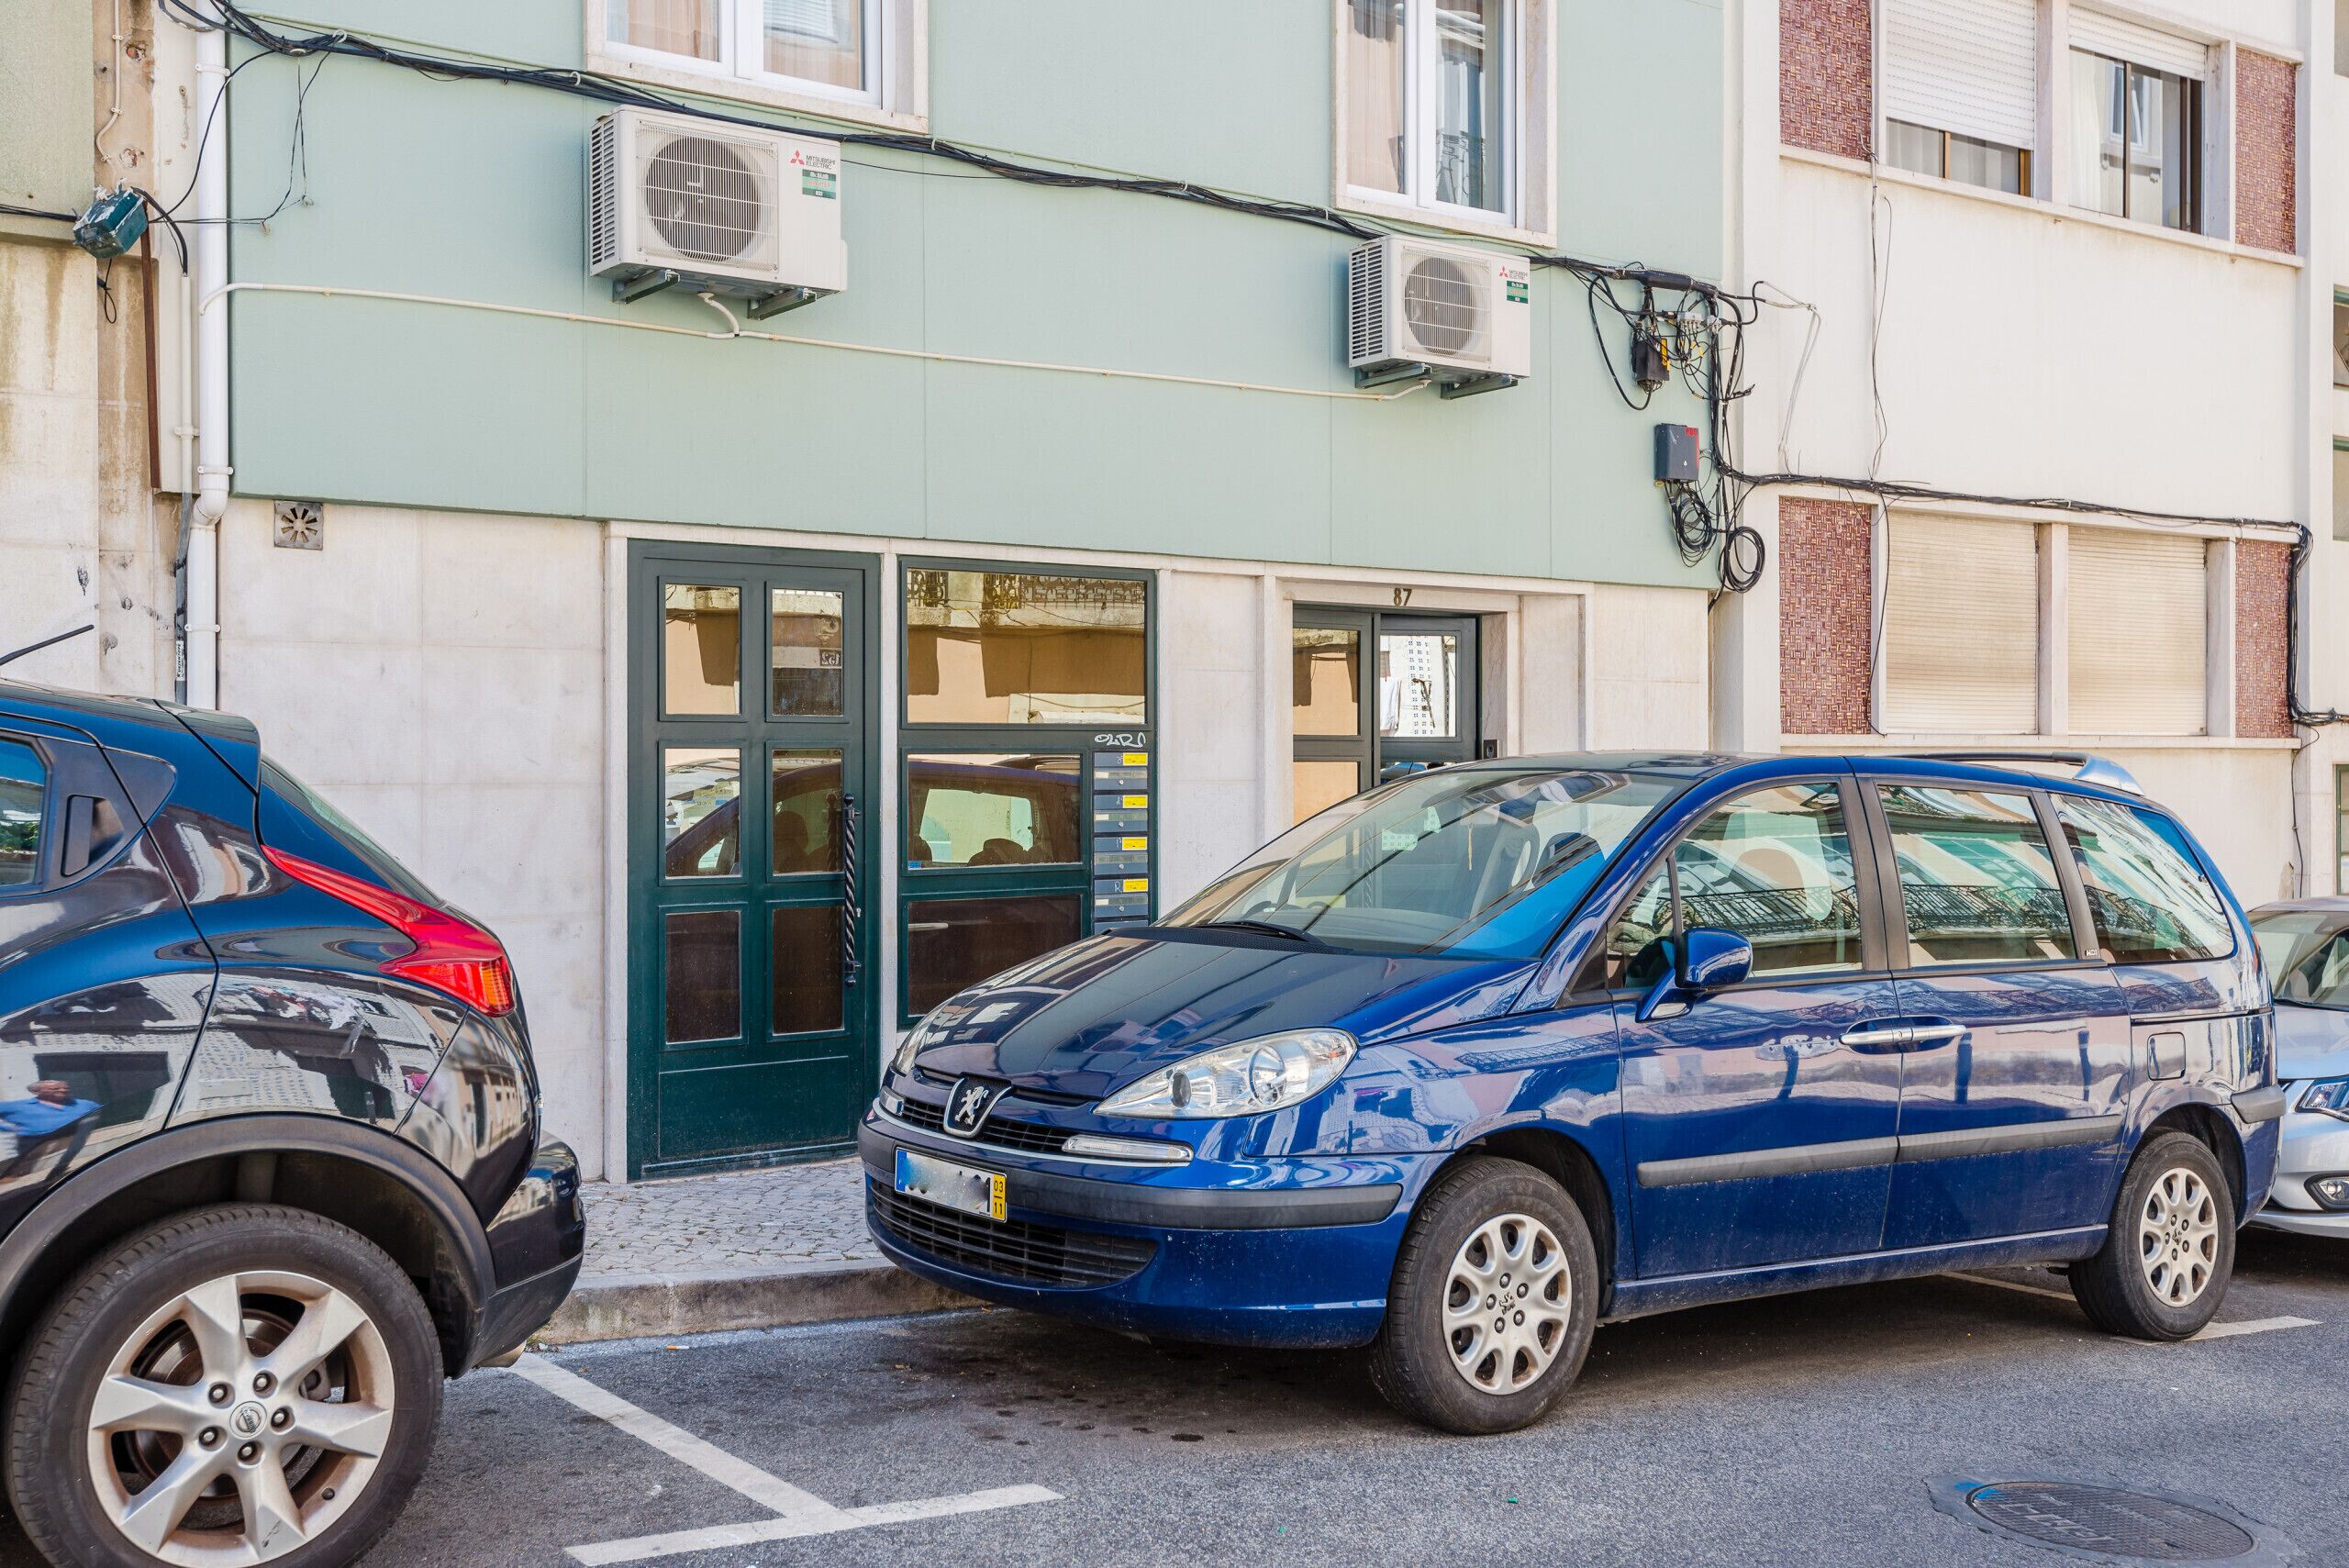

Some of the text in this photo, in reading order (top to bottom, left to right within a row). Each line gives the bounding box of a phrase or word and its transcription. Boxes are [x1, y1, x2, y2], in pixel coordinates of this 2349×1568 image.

[806, 155, 835, 165] MITSUBISHI
[1394, 587, 1412, 606] 87
[2085, 949, 2098, 957] HDI
[994, 1180, 1004, 1193] 03
[994, 1202, 1003, 1215] 11
